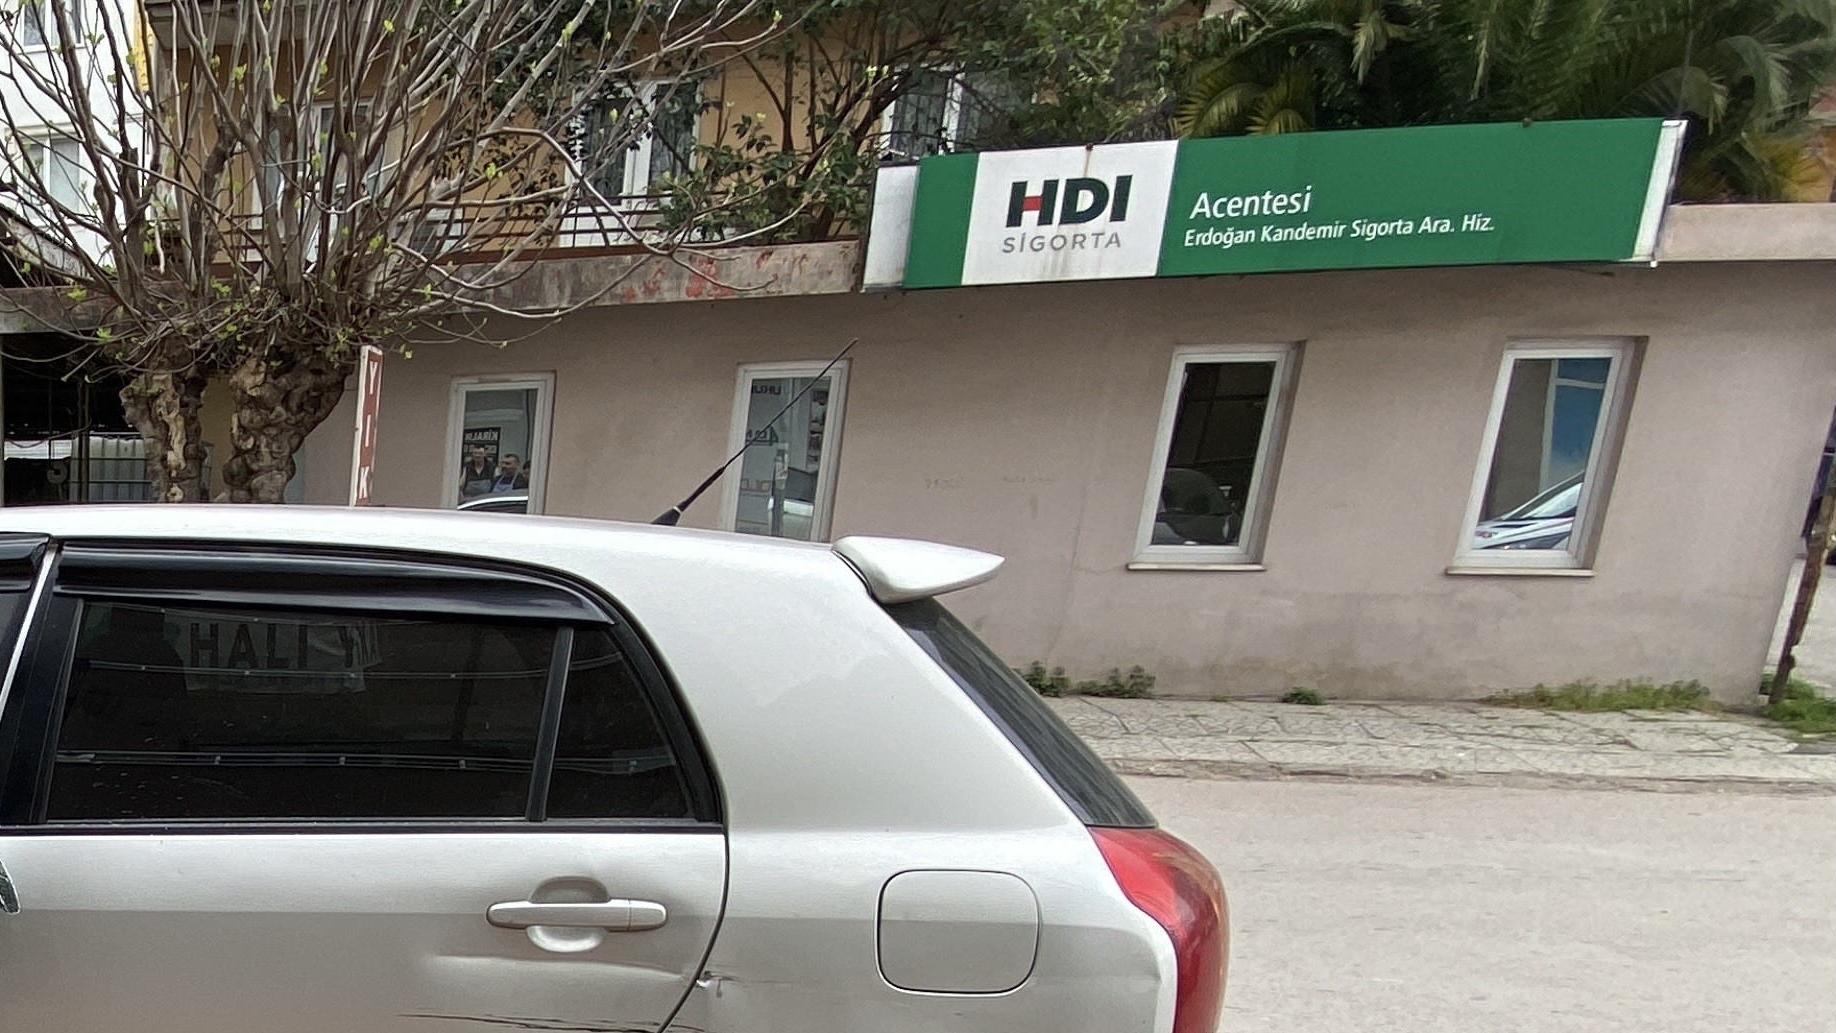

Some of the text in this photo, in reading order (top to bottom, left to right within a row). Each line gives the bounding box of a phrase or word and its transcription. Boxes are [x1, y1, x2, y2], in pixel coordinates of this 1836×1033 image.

[1005, 174, 1133, 228] HDI
[1189, 185, 1312, 219] Acentesi
[1002, 232, 1121, 253] SİGORTA
[1184, 212, 1495, 249] Erdoğan Kandemir Sigorta Ara. Hiz.
